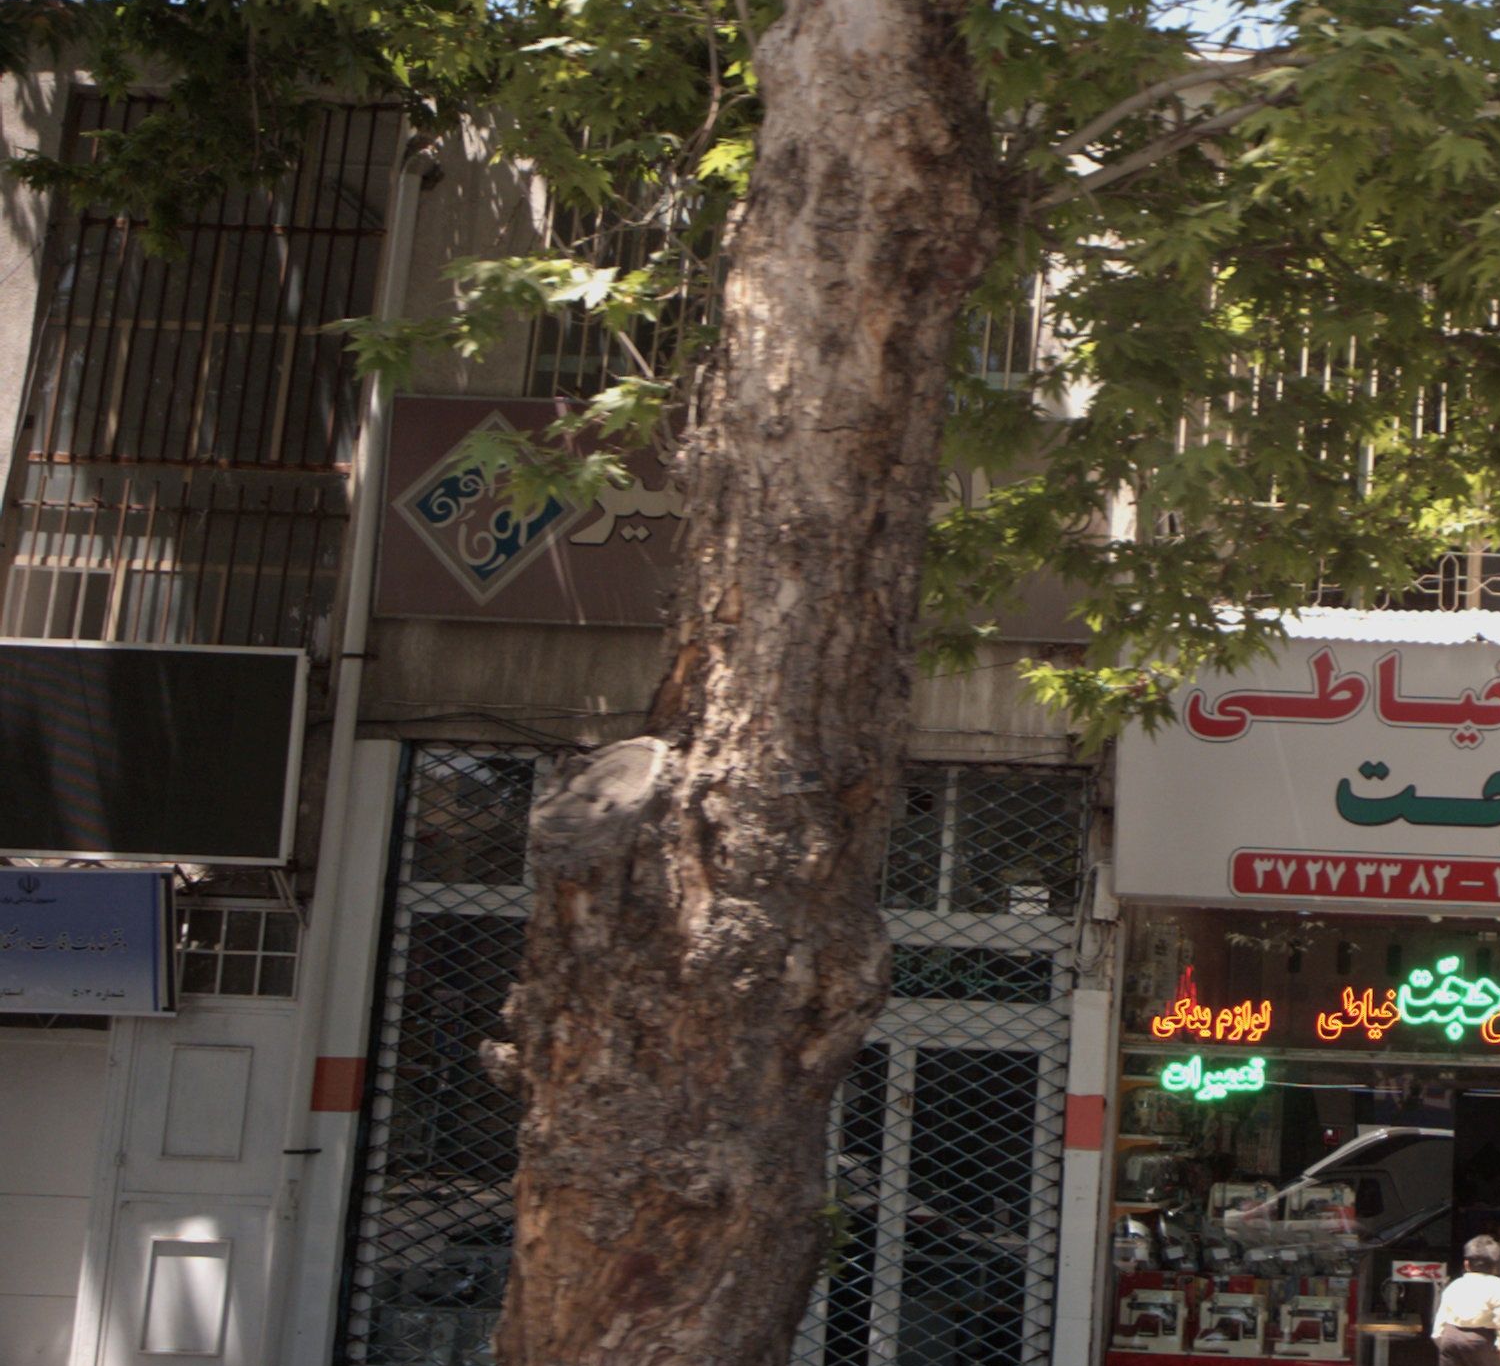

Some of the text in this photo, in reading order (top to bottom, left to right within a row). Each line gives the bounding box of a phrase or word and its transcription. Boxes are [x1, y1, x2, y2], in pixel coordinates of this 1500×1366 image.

[1152, 996, 1273, 1042] لوازم یدکی
[1316, 986, 1401, 1041] خیاطی
[1160, 1055, 1267, 1100] تعمیرات
